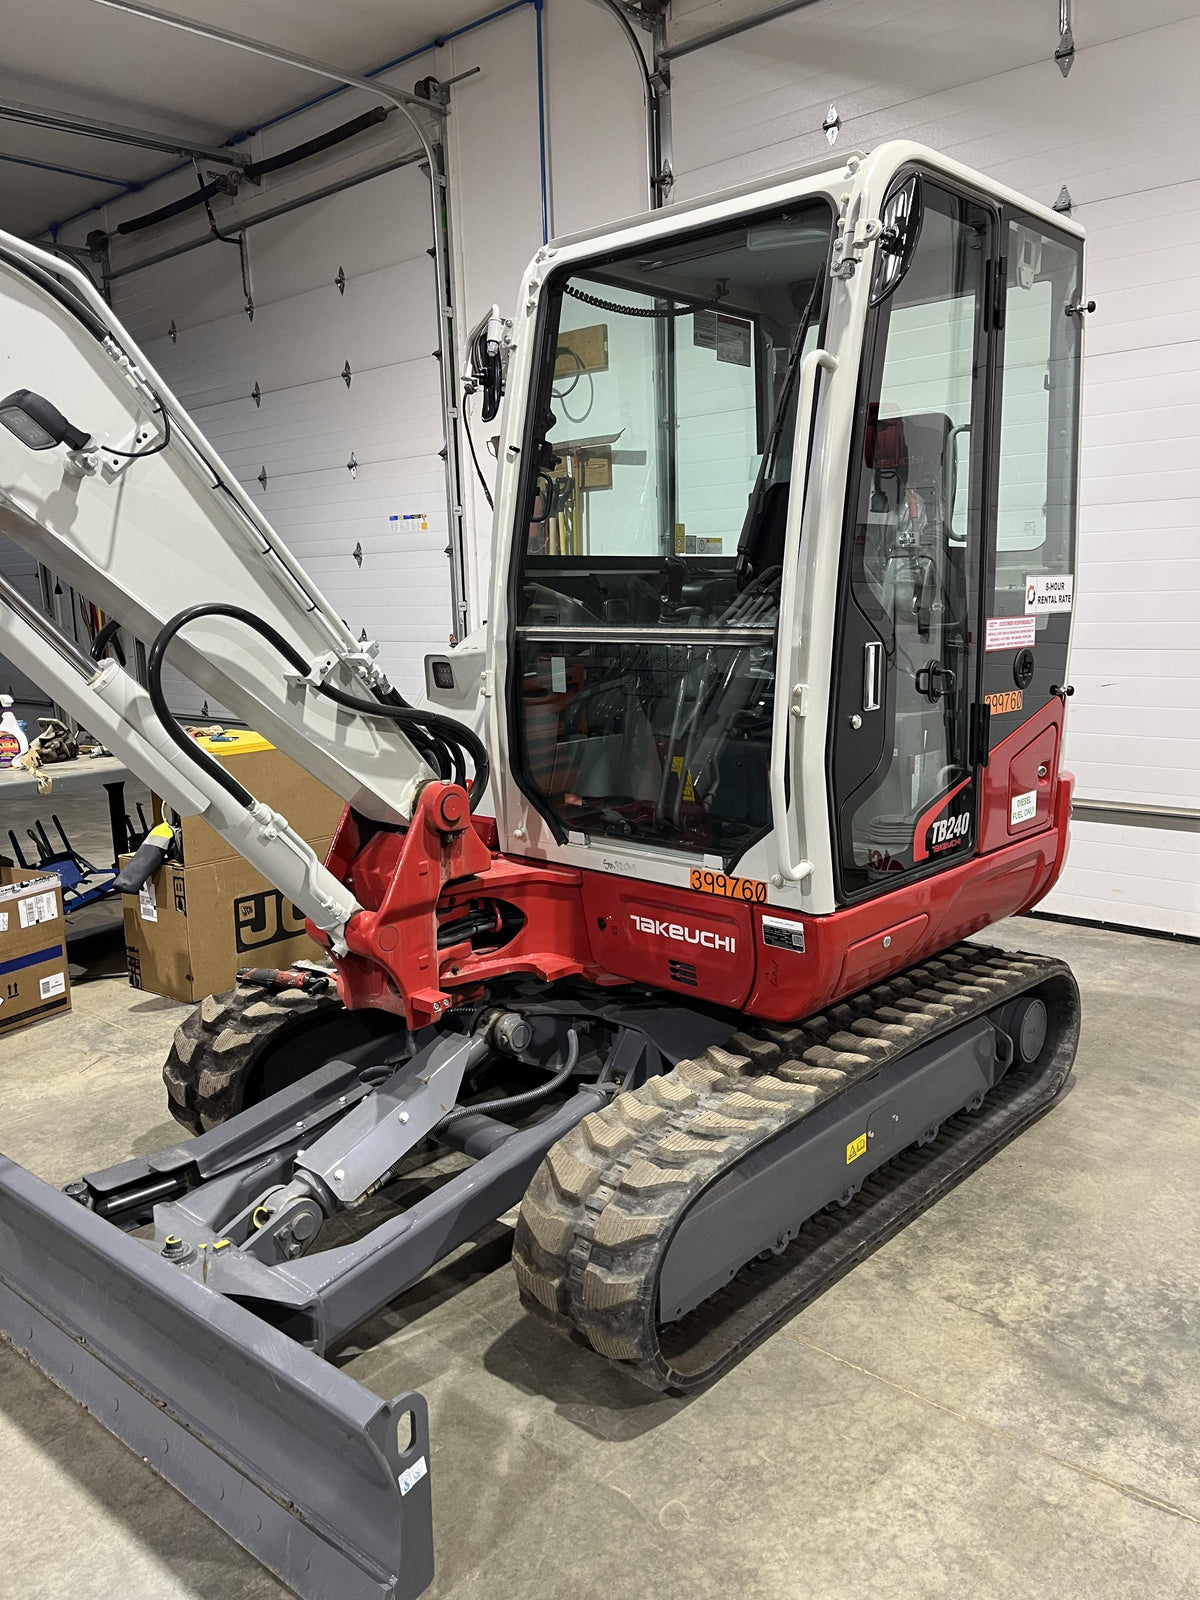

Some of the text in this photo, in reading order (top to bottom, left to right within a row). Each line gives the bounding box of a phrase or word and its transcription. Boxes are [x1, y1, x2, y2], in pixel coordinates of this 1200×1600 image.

[1045, 582, 1065, 592] 8-HOUR
[1037, 594, 1072, 605] RENTAL RATE
[1012, 806, 1036, 821] FUEL ONLY
[1016, 796, 1032, 808] DIESEL
[932, 812, 970, 845] TB240
[691, 869, 768, 904] 399760
[239, 893, 307, 945] JC
[629, 914, 736, 953] TAKEUCHI
